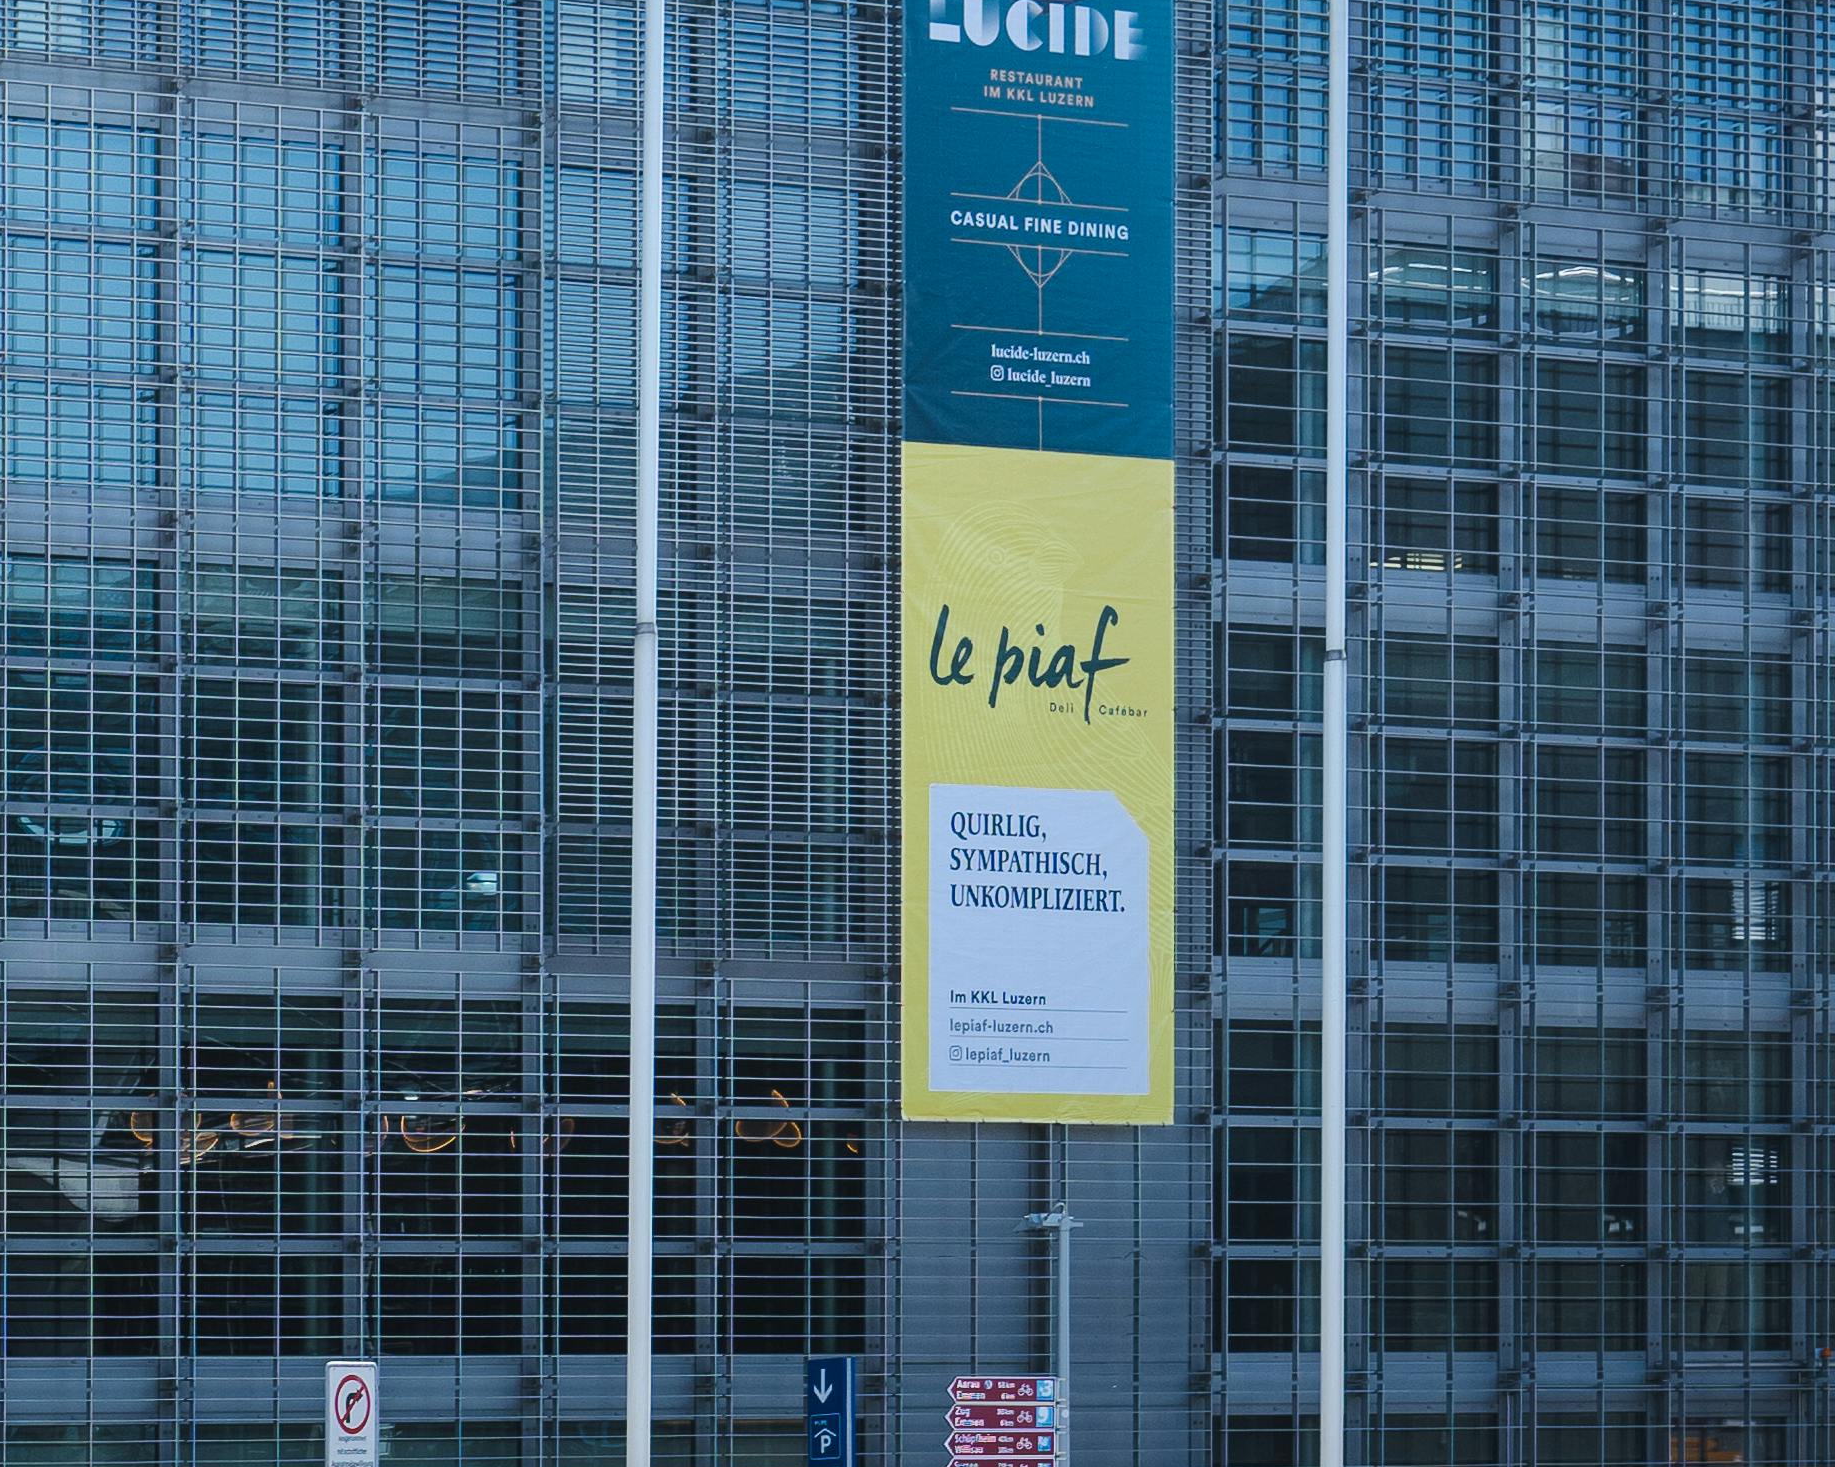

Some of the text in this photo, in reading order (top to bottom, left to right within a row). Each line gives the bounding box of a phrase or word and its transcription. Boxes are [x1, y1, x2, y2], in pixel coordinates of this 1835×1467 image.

[990, 68, 1083, 89] RESTAURANT
[983, 85, 1094, 108] IM KKL LUZERN
[950, 209, 1129, 241] CASUAL FINE DINING
[991, 343, 1091, 365] lucide-luzern.ch
[1007, 367, 1091, 388] lucide_luzern
[929, 604, 1130, 725] le piaf
[1049, 702, 1148, 717] Deli Cafébar
[950, 811, 1047, 843] QUIRLIG,
[949, 847, 1108, 881] SYMPATHISCH,
[950, 883, 1125, 913] UNKOMPLIZIERT.
[950, 990, 1047, 1006] Im KKL Luzern
[949, 1018, 1054, 1035] lepiaf-luzern.ch
[965, 1047, 1051, 1064] lepiaf_luzern
[821, 1434, 832, 1454] P
